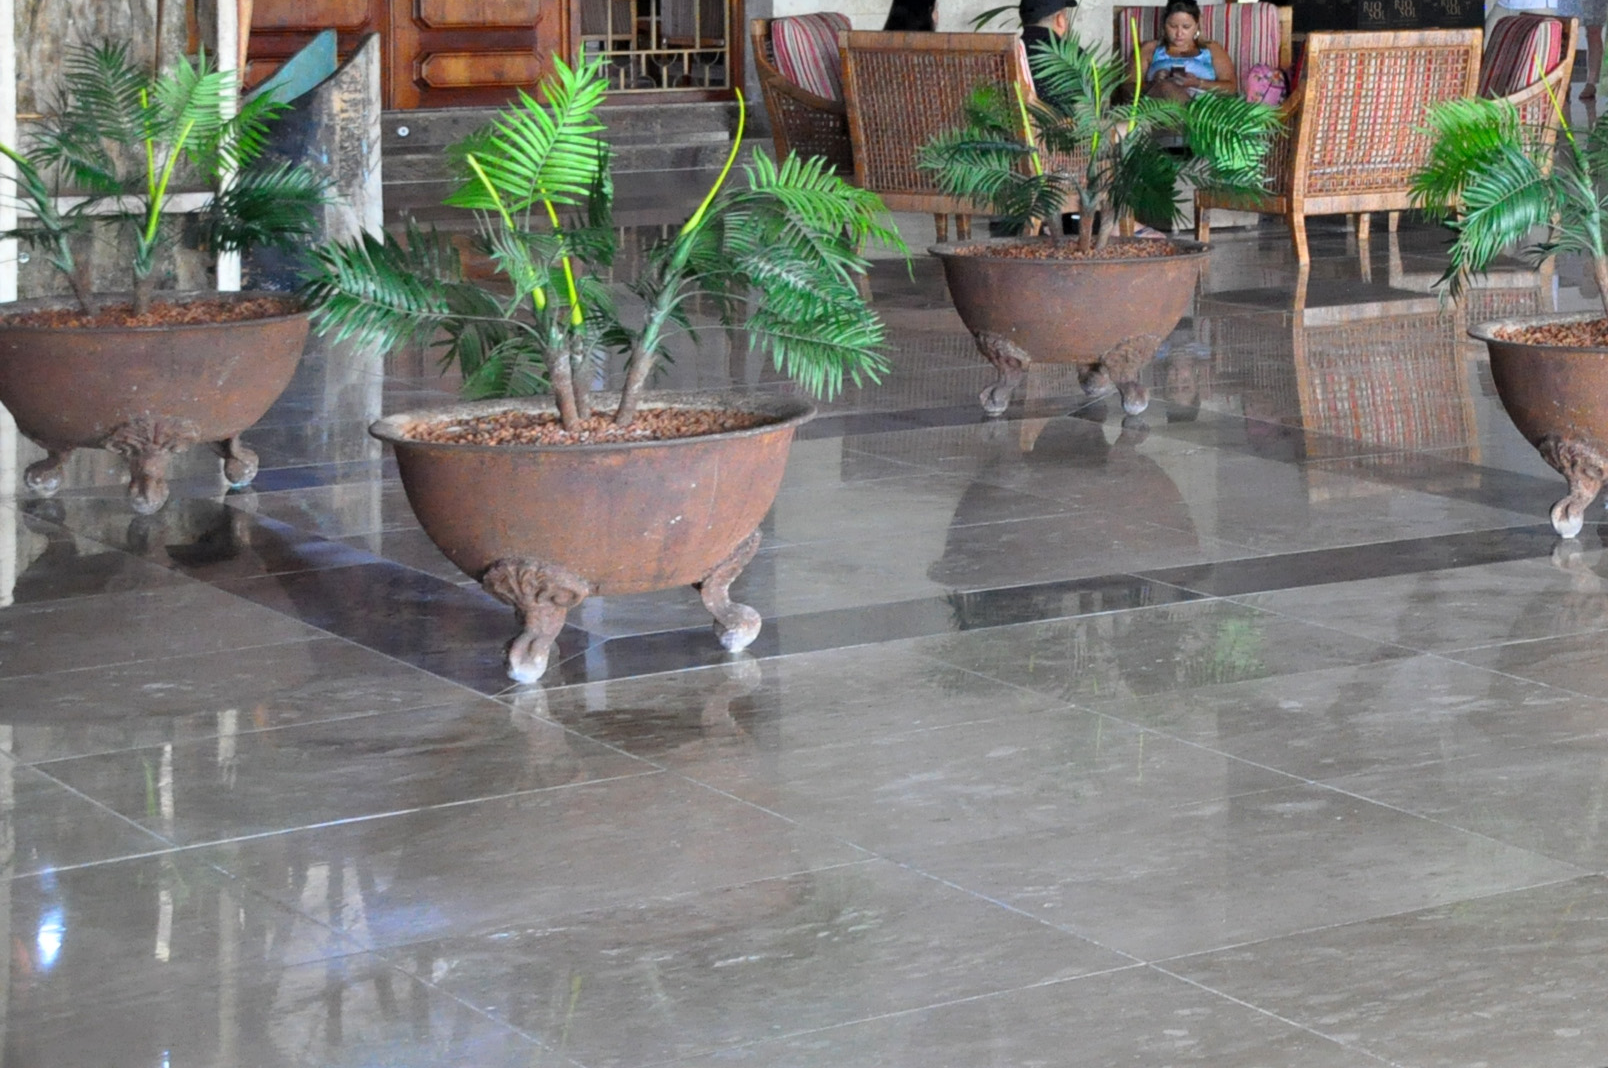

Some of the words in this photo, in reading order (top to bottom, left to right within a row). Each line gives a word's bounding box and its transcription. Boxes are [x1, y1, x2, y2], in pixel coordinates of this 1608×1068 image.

[1363, 1, 1382, 14] RIO
[1400, 7, 1416, 18] SOL
[1446, 4, 1461, 16] SOL
[1369, 9, 1385, 20] SOL
